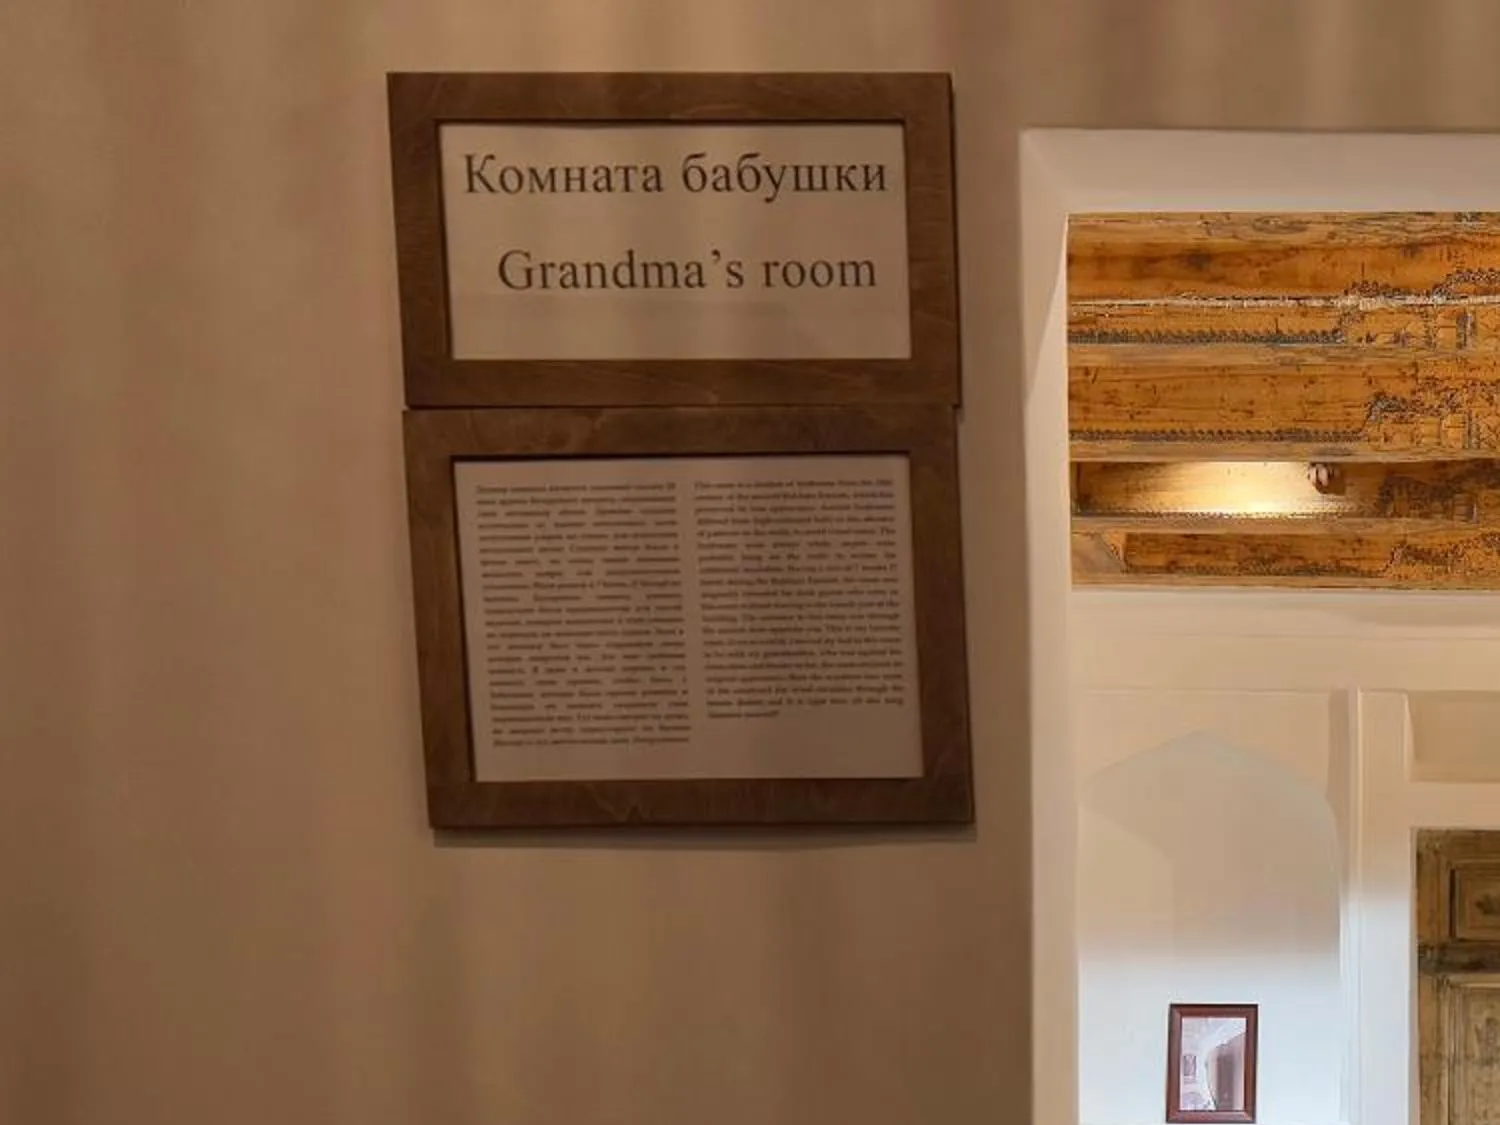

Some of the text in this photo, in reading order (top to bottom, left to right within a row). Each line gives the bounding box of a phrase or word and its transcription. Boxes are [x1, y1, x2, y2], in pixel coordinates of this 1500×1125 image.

[464, 152, 887, 203] Комната бабушки
[498, 248, 877, 290] Grandma’s room
